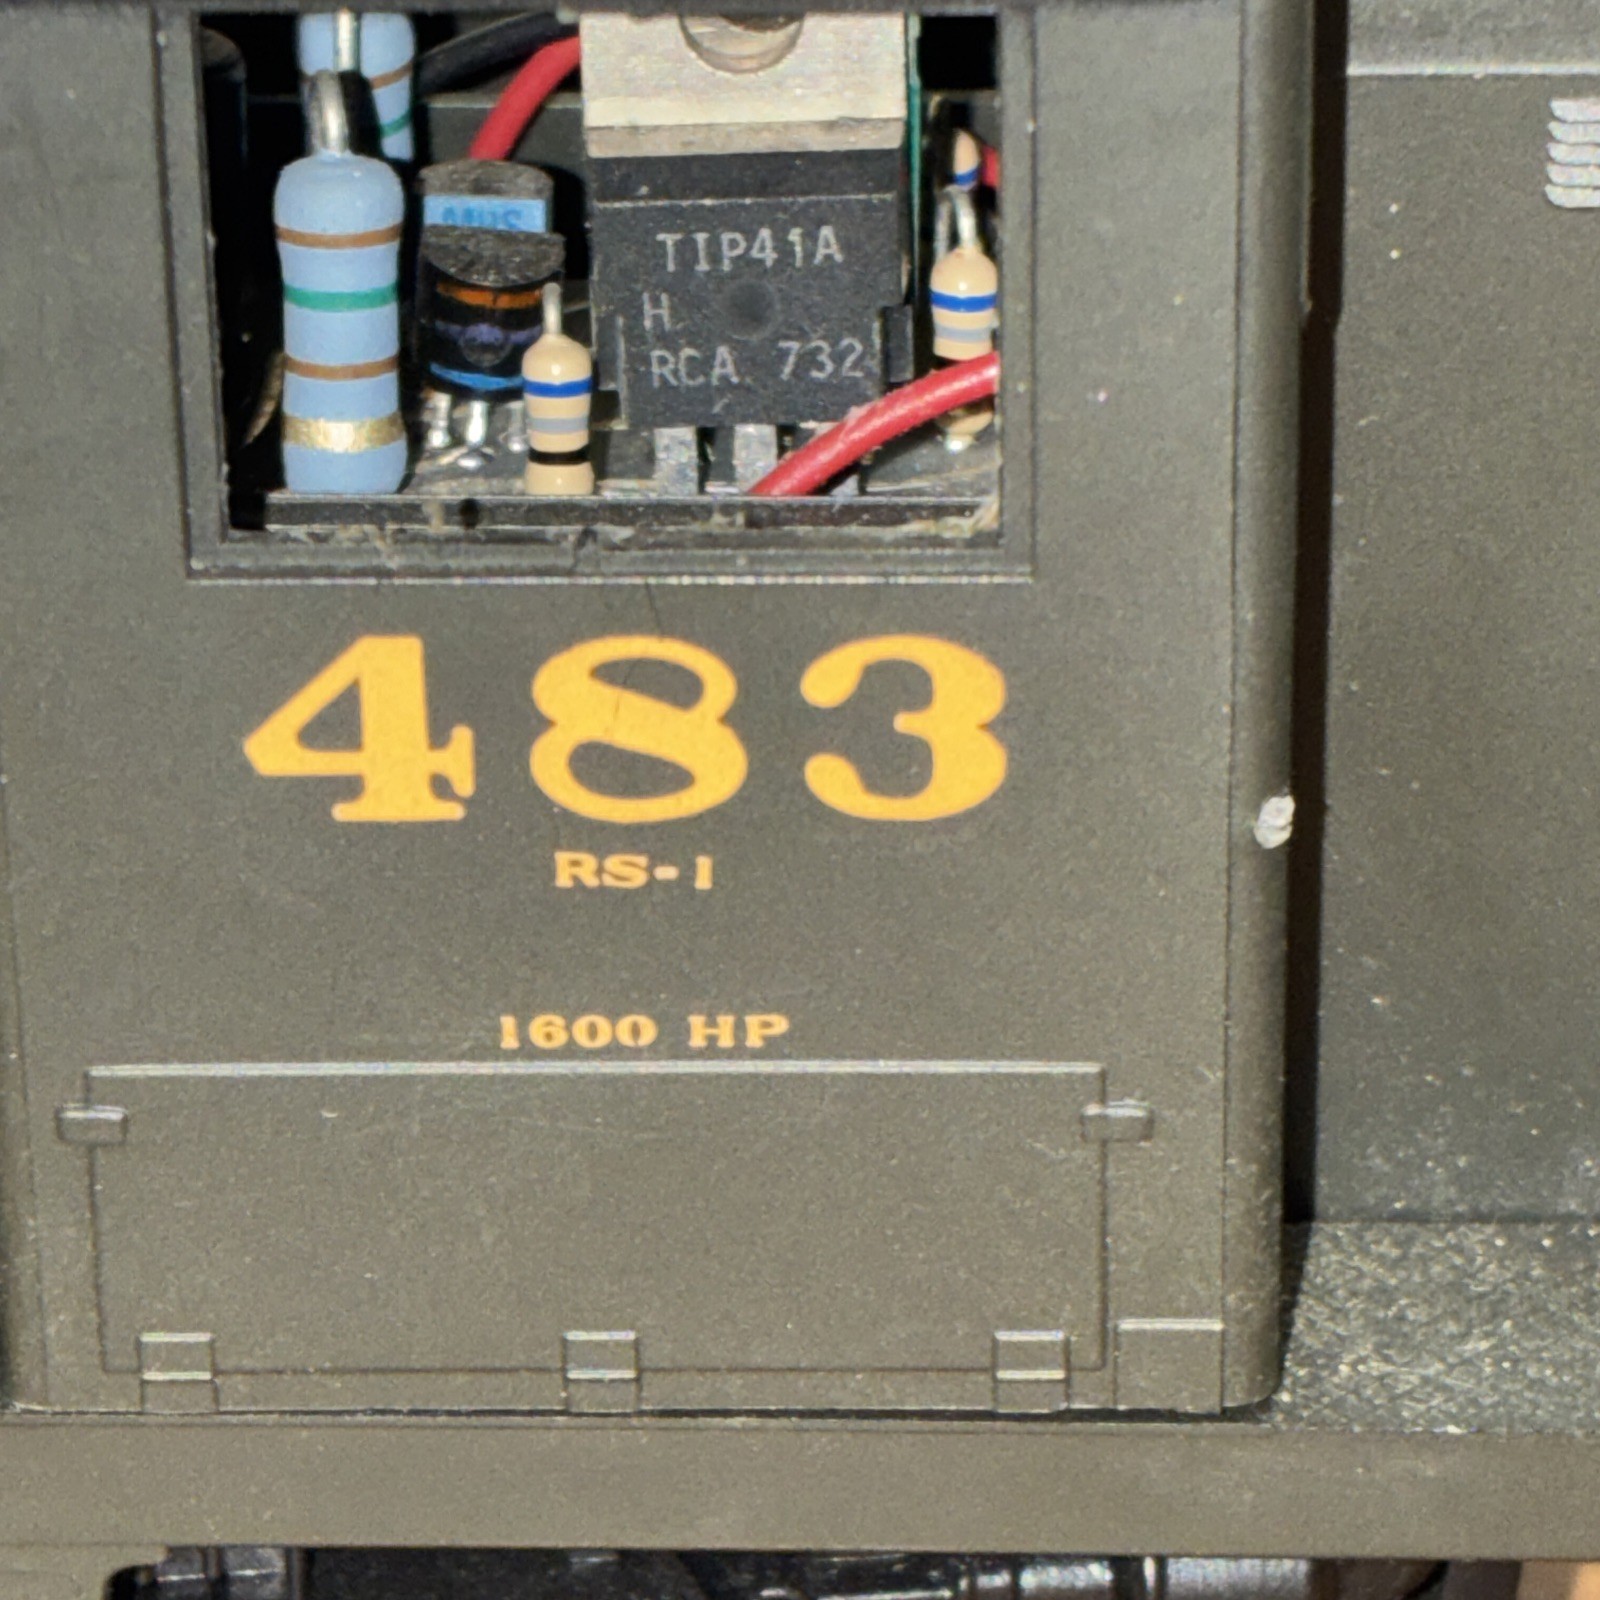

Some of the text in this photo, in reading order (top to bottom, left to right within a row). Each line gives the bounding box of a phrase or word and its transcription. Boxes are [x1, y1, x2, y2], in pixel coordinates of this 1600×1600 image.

[656, 225, 844, 272] TIP41A
[642, 292, 672, 332] H
[650, 337, 865, 388] RCA 732
[243, 634, 1008, 824] 483
[553, 851, 713, 890] RS-1
[499, 1014, 790, 1049] 1600 HP
